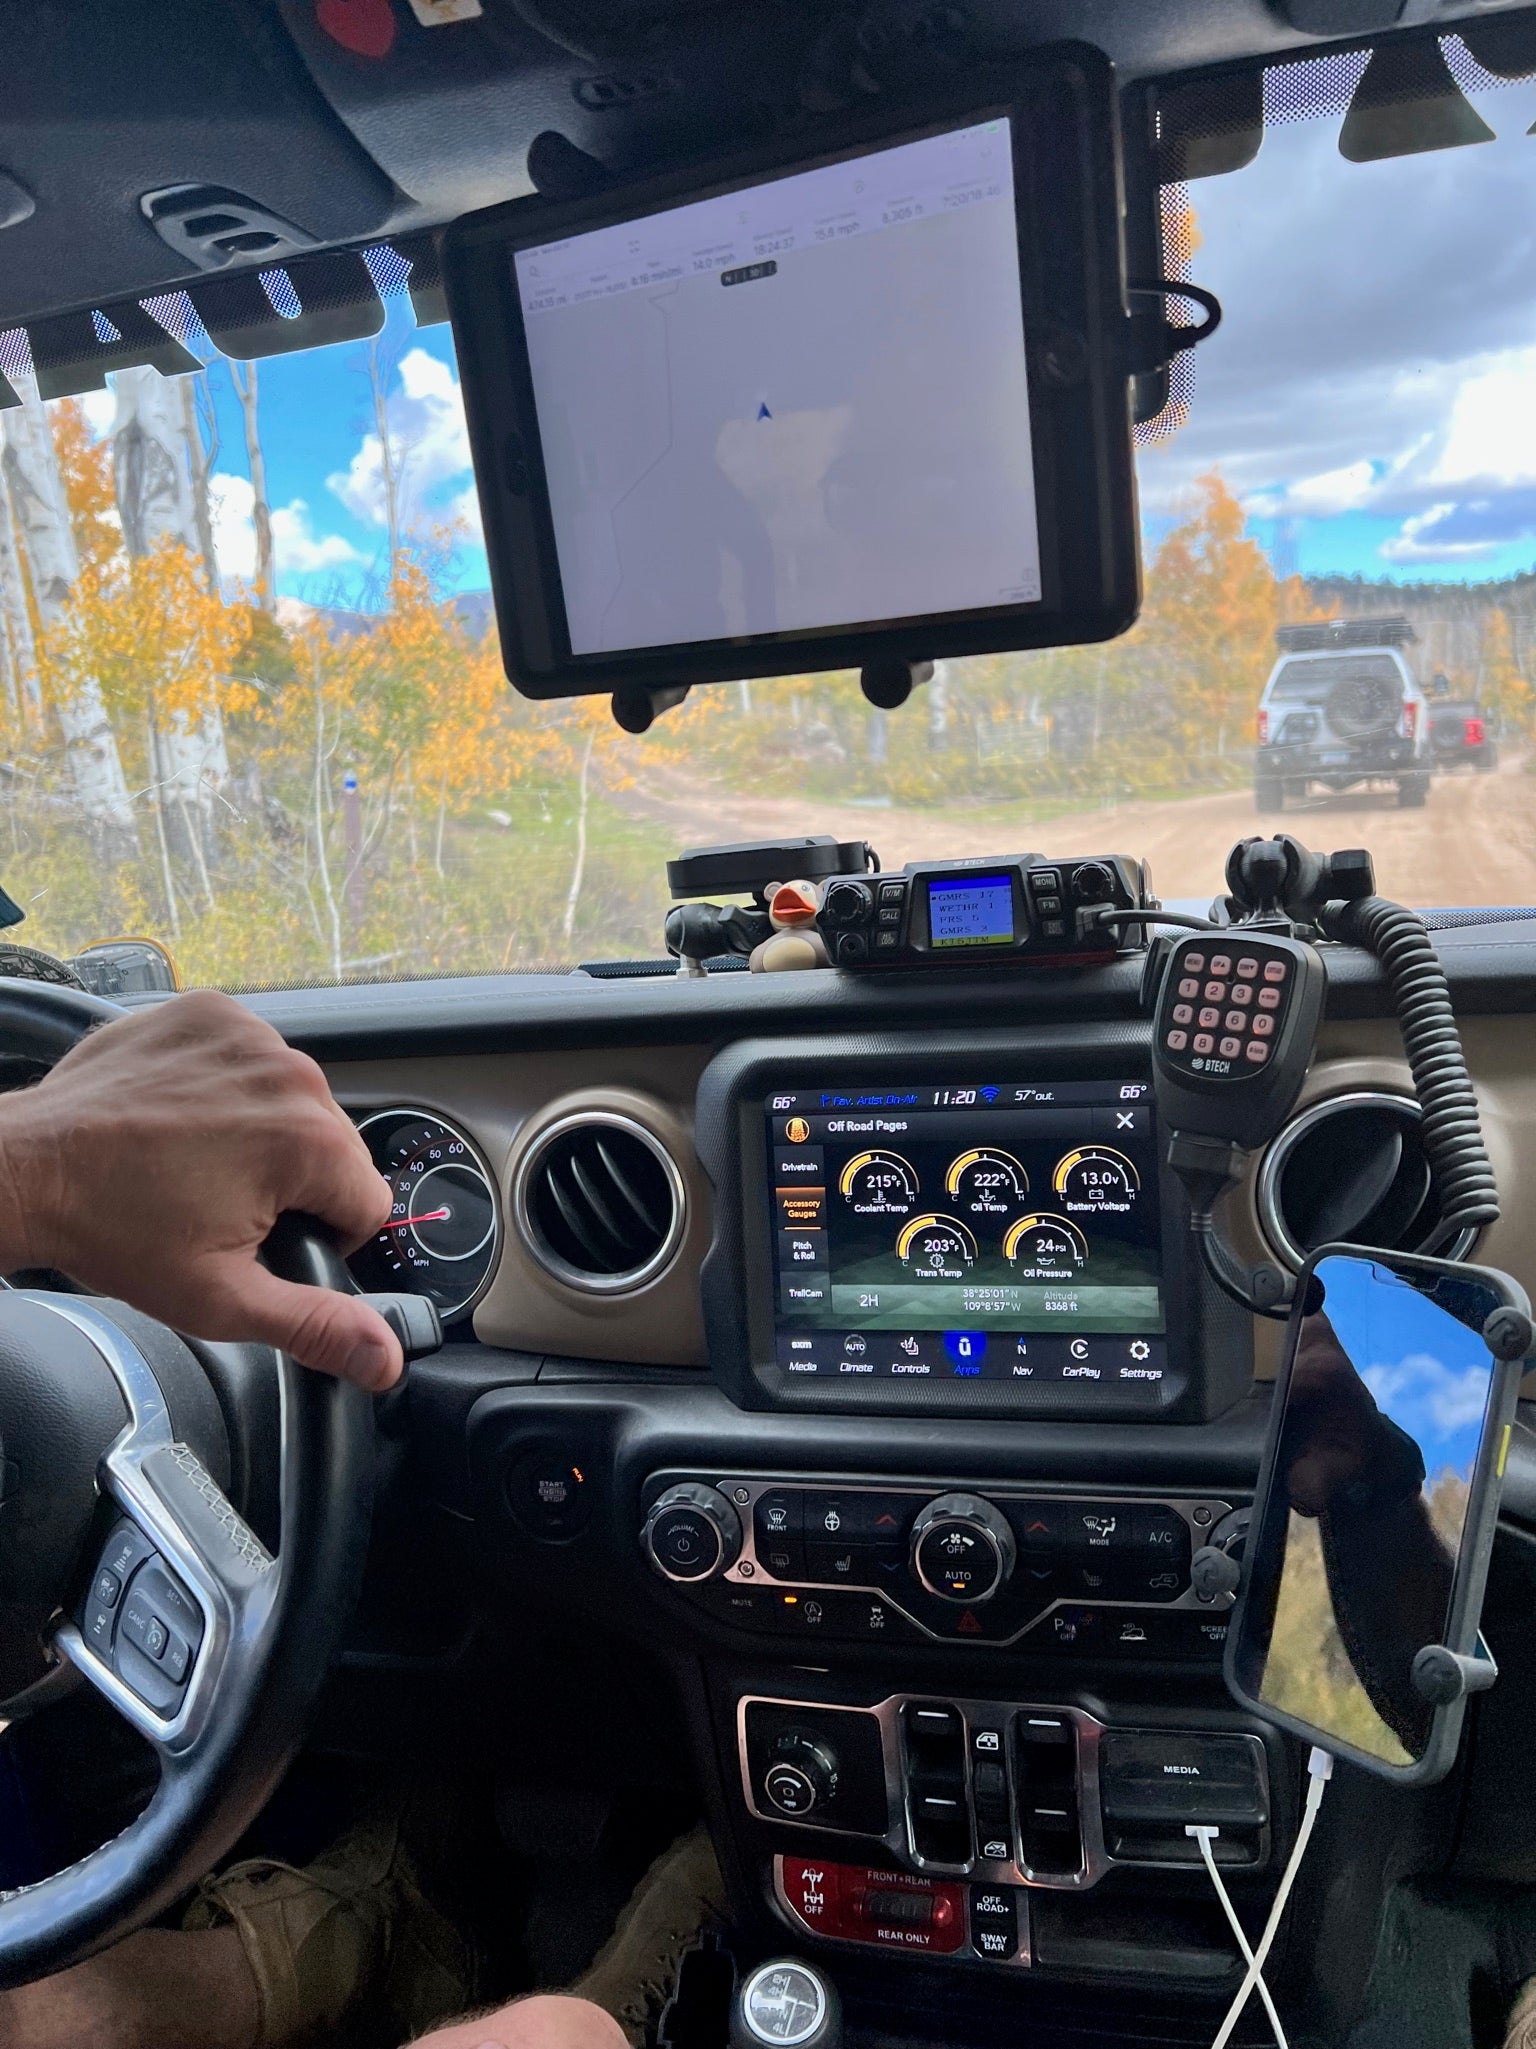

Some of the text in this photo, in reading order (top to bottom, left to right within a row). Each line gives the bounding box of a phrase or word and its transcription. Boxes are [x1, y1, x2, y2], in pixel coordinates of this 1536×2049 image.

[715, 254, 735, 267] mph
[938, 893, 970, 901] GMRS
[882, 912, 898, 920] CALL
[940, 926, 972, 935] GMRS
[1186, 982, 1245, 998] 1 2 3
[1178, 1009, 1266, 1029] 4 5 6 0
[1173, 1034, 1234, 1052] 7 8 9
[1205, 1059, 1230, 1073] BTECH
[833, 1096, 854, 1106] Fav.
[857, 1096, 882, 1106] Artist
[933, 1090, 976, 1104] 11:20
[828, 1120, 908, 1133] Off Road Pages
[449, 1142, 464, 1154] 60
[429, 1150, 442, 1160] 50
[410, 1161, 424, 1172] 40
[782, 1163, 818, 1172] Drivetrain
[400, 1182, 410, 1192] 30
[393, 1203, 406, 1214] 20
[783, 1200, 820, 1209] Accessory
[854, 1204, 909, 1214] Coolant Temp
[971, 1203, 1008, 1212] Oil Temp
[1067, 1202, 1130, 1212] Battery Voltage
[788, 1210, 817, 1219] Gauges
[398, 1228, 406, 1238] 10
[793, 1242, 812, 1250] Pitch
[408, 1247, 414, 1259] 0
[801, 1251, 816, 1260] Roll
[414, 1259, 430, 1267] MPH
[968, 1260, 974, 1268] H
[1078, 1260, 1084, 1268] H
[916, 1269, 962, 1278] Trans Temp
[1024, 1268, 1073, 1278] Oil Pressure
[789, 1288, 823, 1298] TrailCam
[1011, 1290, 1018, 1299] N
[1044, 1292, 1079, 1300] Altitude
[860, 1294, 879, 1308] 2H
[1012, 1303, 1021, 1312] W
[1045, 1302, 1078, 1312] 8368 ft
[845, 1343, 866, 1352] AUTO
[1017, 1344, 1027, 1355] N
[788, 1362, 818, 1372] Media
[840, 1362, 874, 1373] Climate
[891, 1364, 930, 1374] Controls
[954, 1365, 980, 1376] Apps
[1012, 1366, 1034, 1376] Nav
[1062, 1366, 1100, 1380] CarPlay
[1120, 1368, 1163, 1380] Settings
[540, 1480, 564, 1488] START
[768, 1524, 787, 1532] FRONT
[1089, 1538, 1110, 1546] MODE
[1149, 1530, 1172, 1544] A/C
[946, 1544, 966, 1554] OFF
[944, 1571, 972, 1582] AUTO
[127, 1609, 145, 1630] CANC
[806, 1616, 822, 1624] OFF
[1054, 1618, 1064, 1631] P
[172, 1652, 184, 1668] RES
[1164, 1765, 1200, 1774] MEDIA
[982, 1895, 1001, 1904] OFF
[804, 1904, 824, 1916] OFF
[878, 1929, 930, 1944] REAR ONLY
[980, 1933, 1008, 1944] SWAY
[984, 1942, 1005, 1952] BAR
[772, 2022, 784, 2035] 4L
